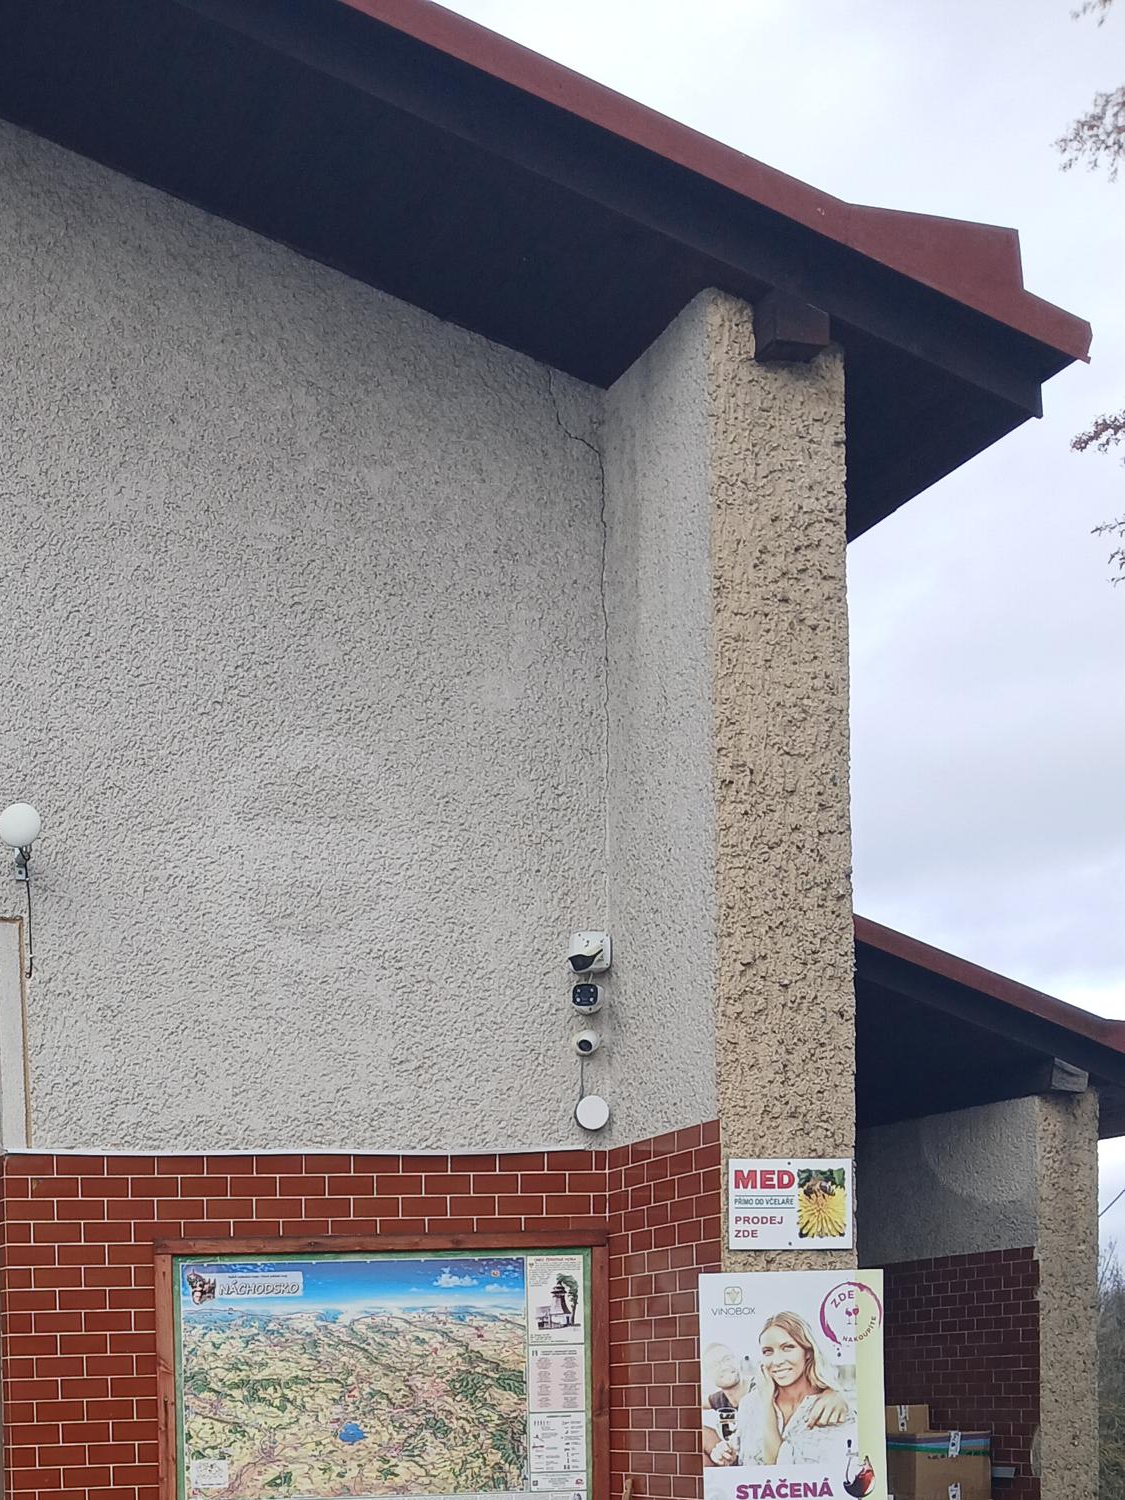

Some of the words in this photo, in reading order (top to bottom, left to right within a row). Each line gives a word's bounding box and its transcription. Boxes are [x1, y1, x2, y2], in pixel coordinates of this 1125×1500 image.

[734, 1170, 795, 1189] MED
[735, 1216, 784, 1225] PRODEJ
[735, 1229, 759, 1239] ZDE
[219, 1280, 300, 1296] NÁCHODSKO
[831, 1290, 855, 1309] ZDE
[711, 1307, 756, 1316] VINOBOX
[736, 1477, 834, 1499] STÁČENÁ
